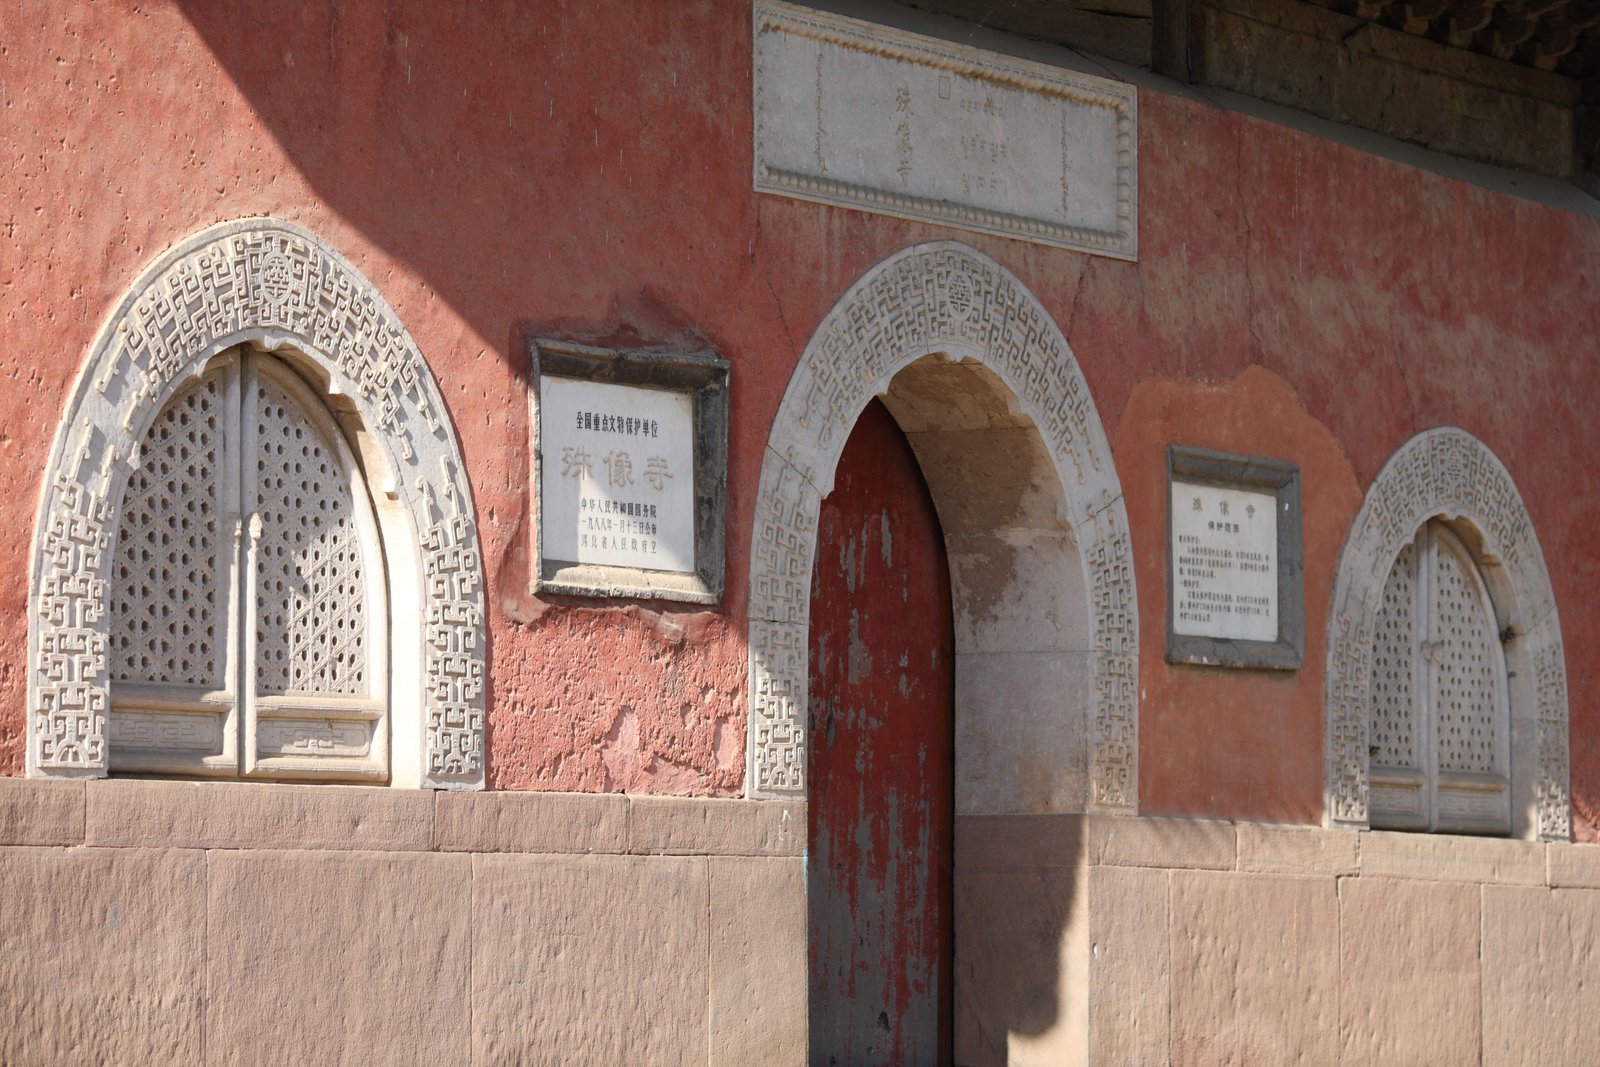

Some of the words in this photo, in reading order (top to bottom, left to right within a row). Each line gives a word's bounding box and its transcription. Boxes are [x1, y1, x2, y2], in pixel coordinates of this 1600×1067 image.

[576, 411, 659, 438] 全国重点文物保护单位
[561, 445, 674, 492] 殊像寺
[581, 497, 657, 519] 中华人民共和国国务院
[581, 516, 657, 536] 一九八八年一月十三日公布
[581, 534, 657, 554] 河北省人民政府立
